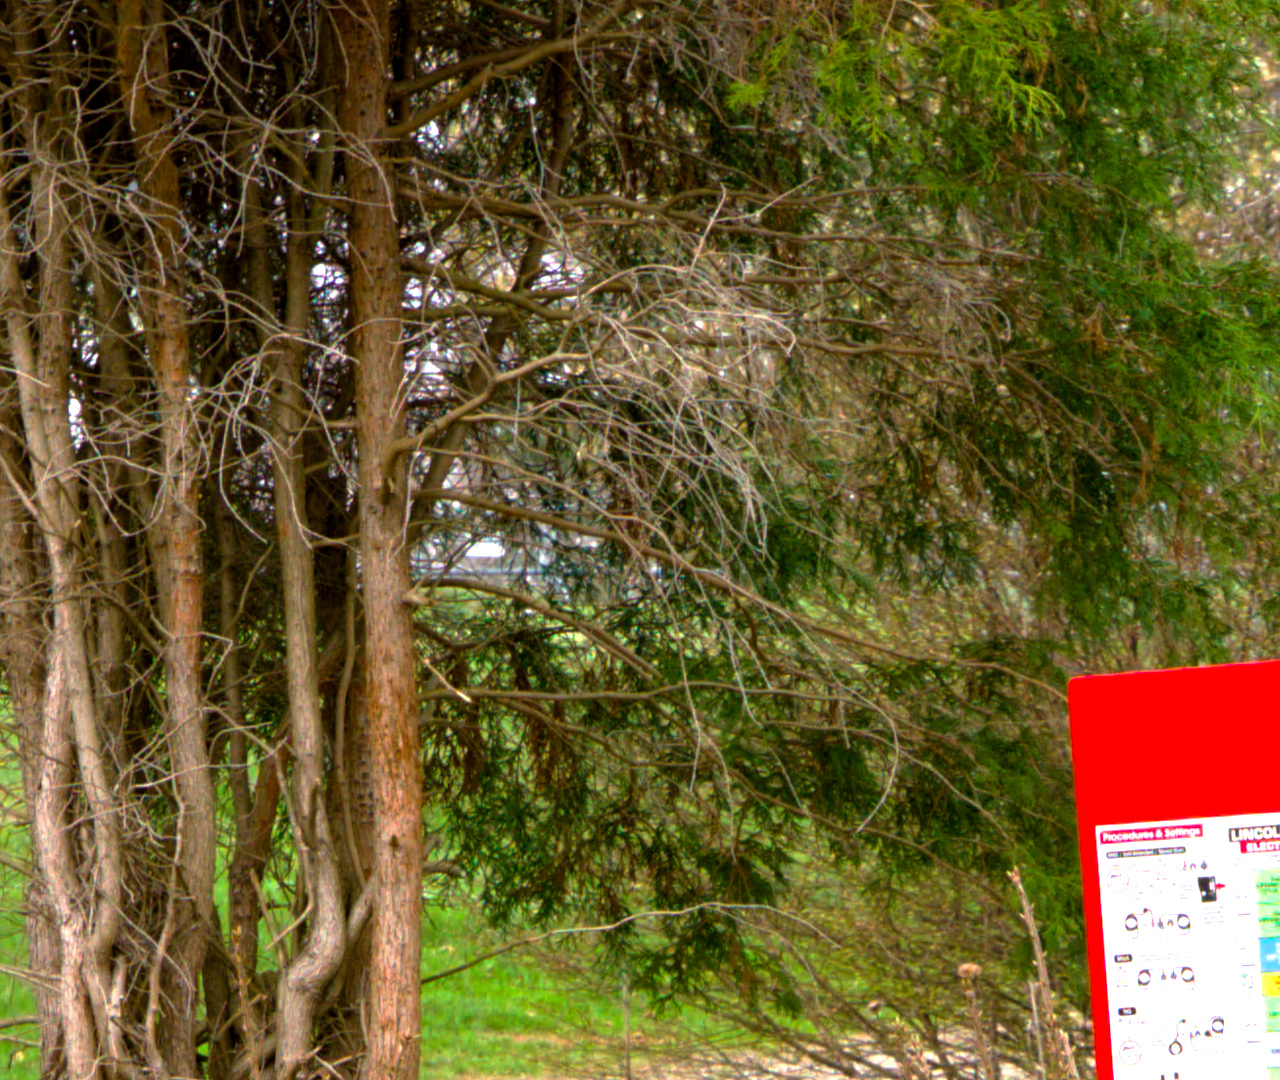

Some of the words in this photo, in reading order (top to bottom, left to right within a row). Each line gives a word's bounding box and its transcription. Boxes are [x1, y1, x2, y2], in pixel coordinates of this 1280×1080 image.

[1102, 830, 1153, 842] Procedures
[1155, 830, 1163, 838] &
[1164, 826, 1200, 837] Settings
